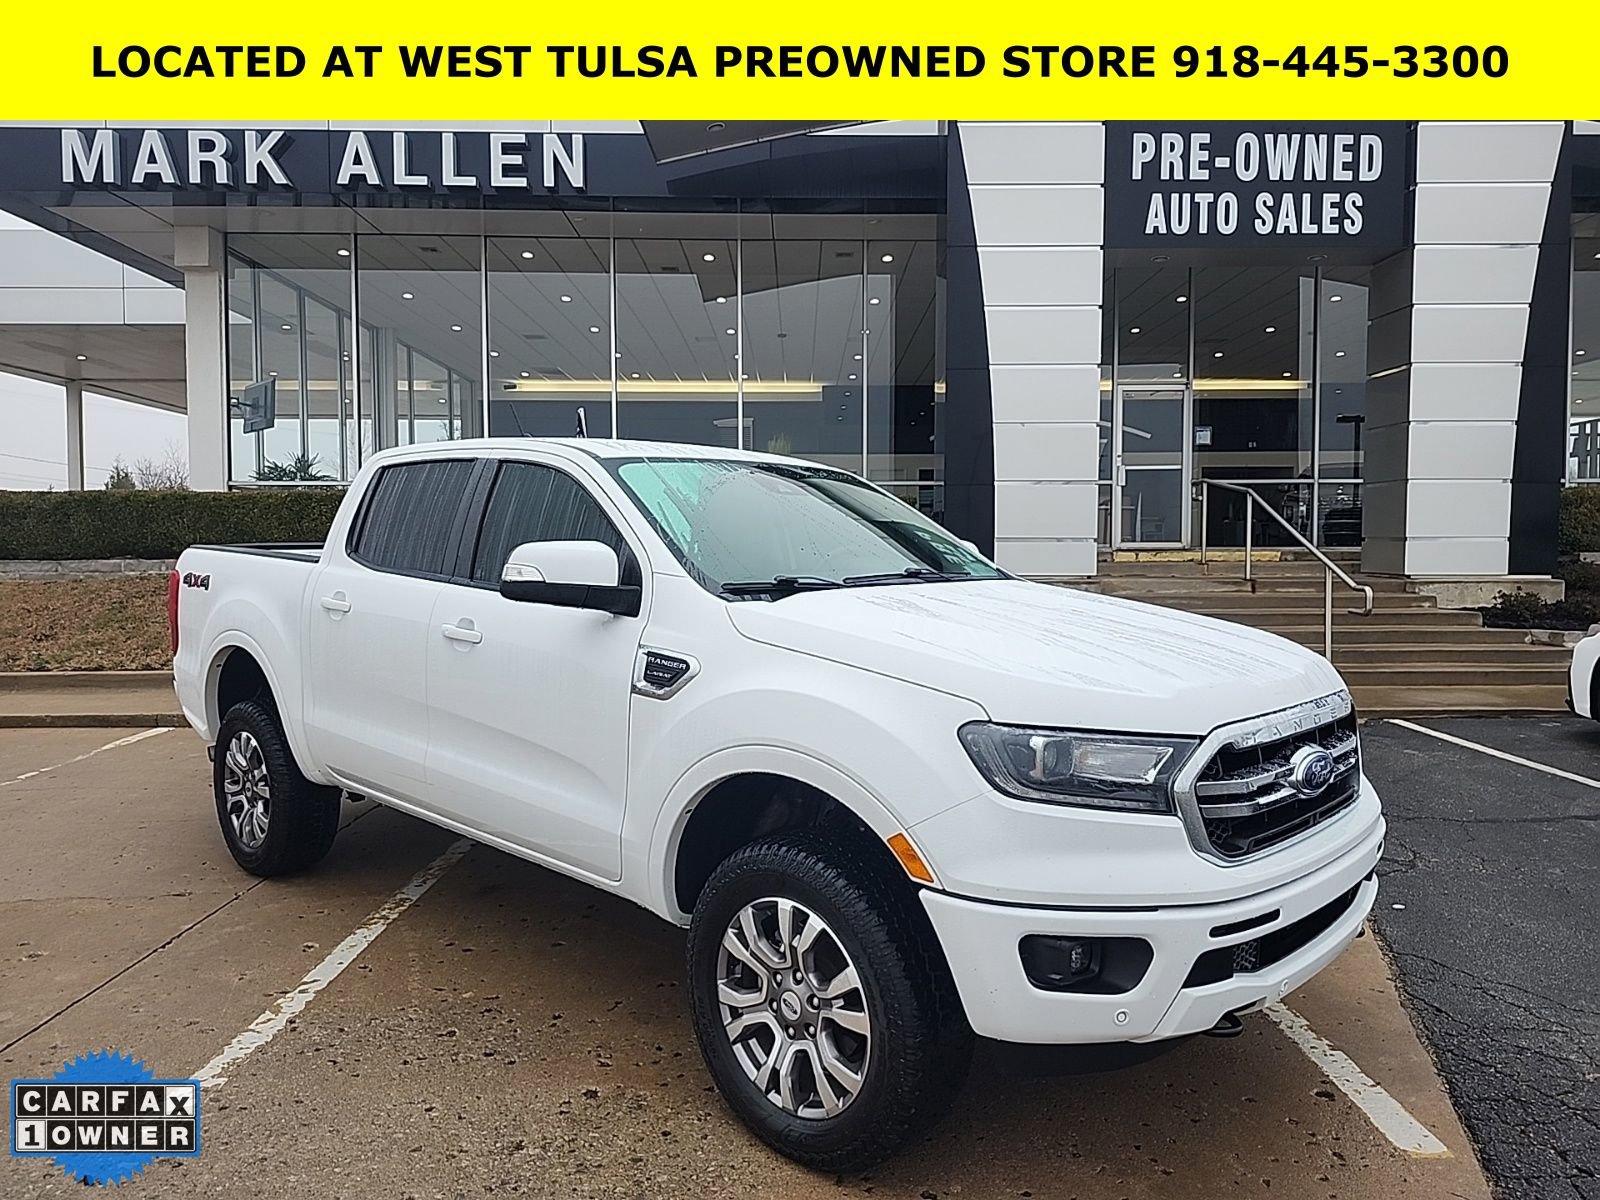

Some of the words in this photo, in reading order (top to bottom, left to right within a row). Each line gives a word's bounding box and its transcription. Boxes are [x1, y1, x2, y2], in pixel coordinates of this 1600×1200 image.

[61, 128, 288, 187] MARK
[336, 131, 587, 189] ALLEN
[1131, 132, 1384, 182] PRE-OWNED
[1144, 192, 1239, 235] AUTO
[1254, 192, 1364, 235] SALES
[648, 656, 686, 669] RANGER
